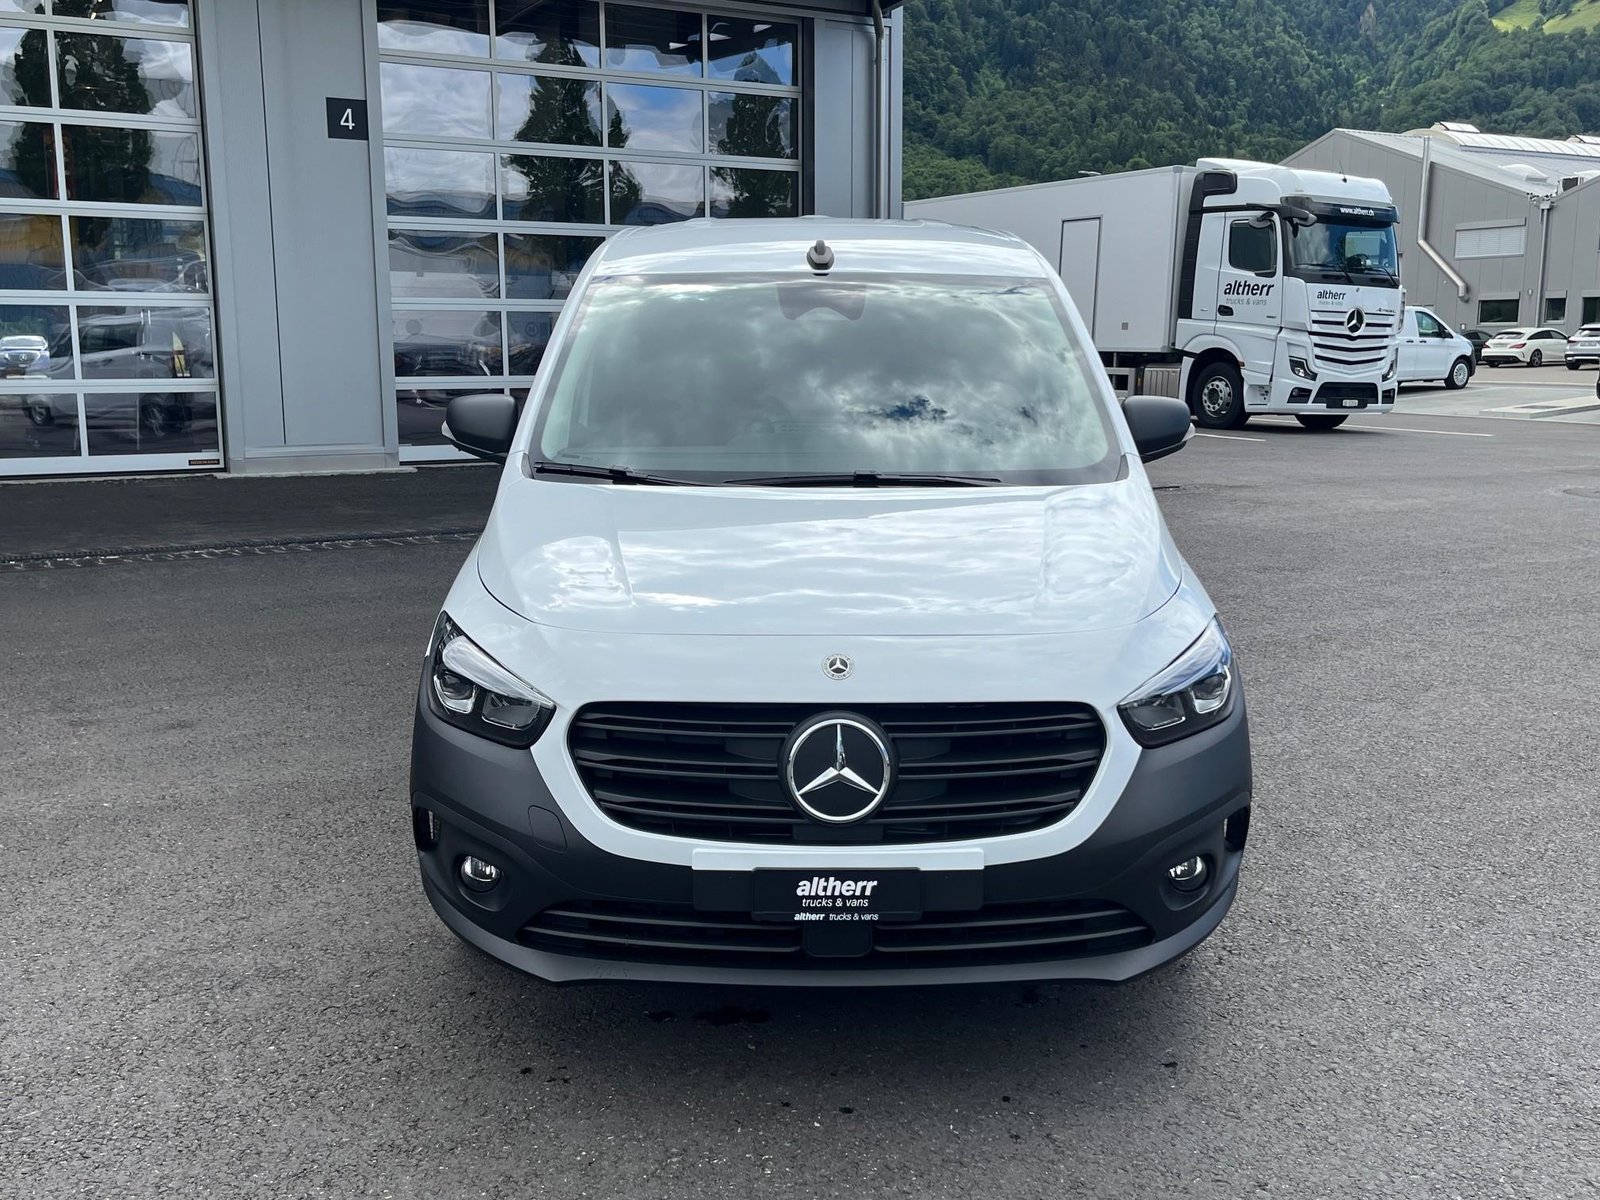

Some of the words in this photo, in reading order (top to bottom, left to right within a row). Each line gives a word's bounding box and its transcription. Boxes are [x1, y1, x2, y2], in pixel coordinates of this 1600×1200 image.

[340, 108, 355, 130] 4
[1340, 207, 1374, 216] www.altherr.ch
[1223, 280, 1274, 296] altherr
[1316, 290, 1346, 300] altherr
[796, 876, 878, 896] altherr
[802, 898, 833, 907] trucks
[835, 898, 843, 907] &
[845, 899, 869, 907] vans
[794, 912, 825, 920] altherr
[829, 912, 852, 920] trucks
